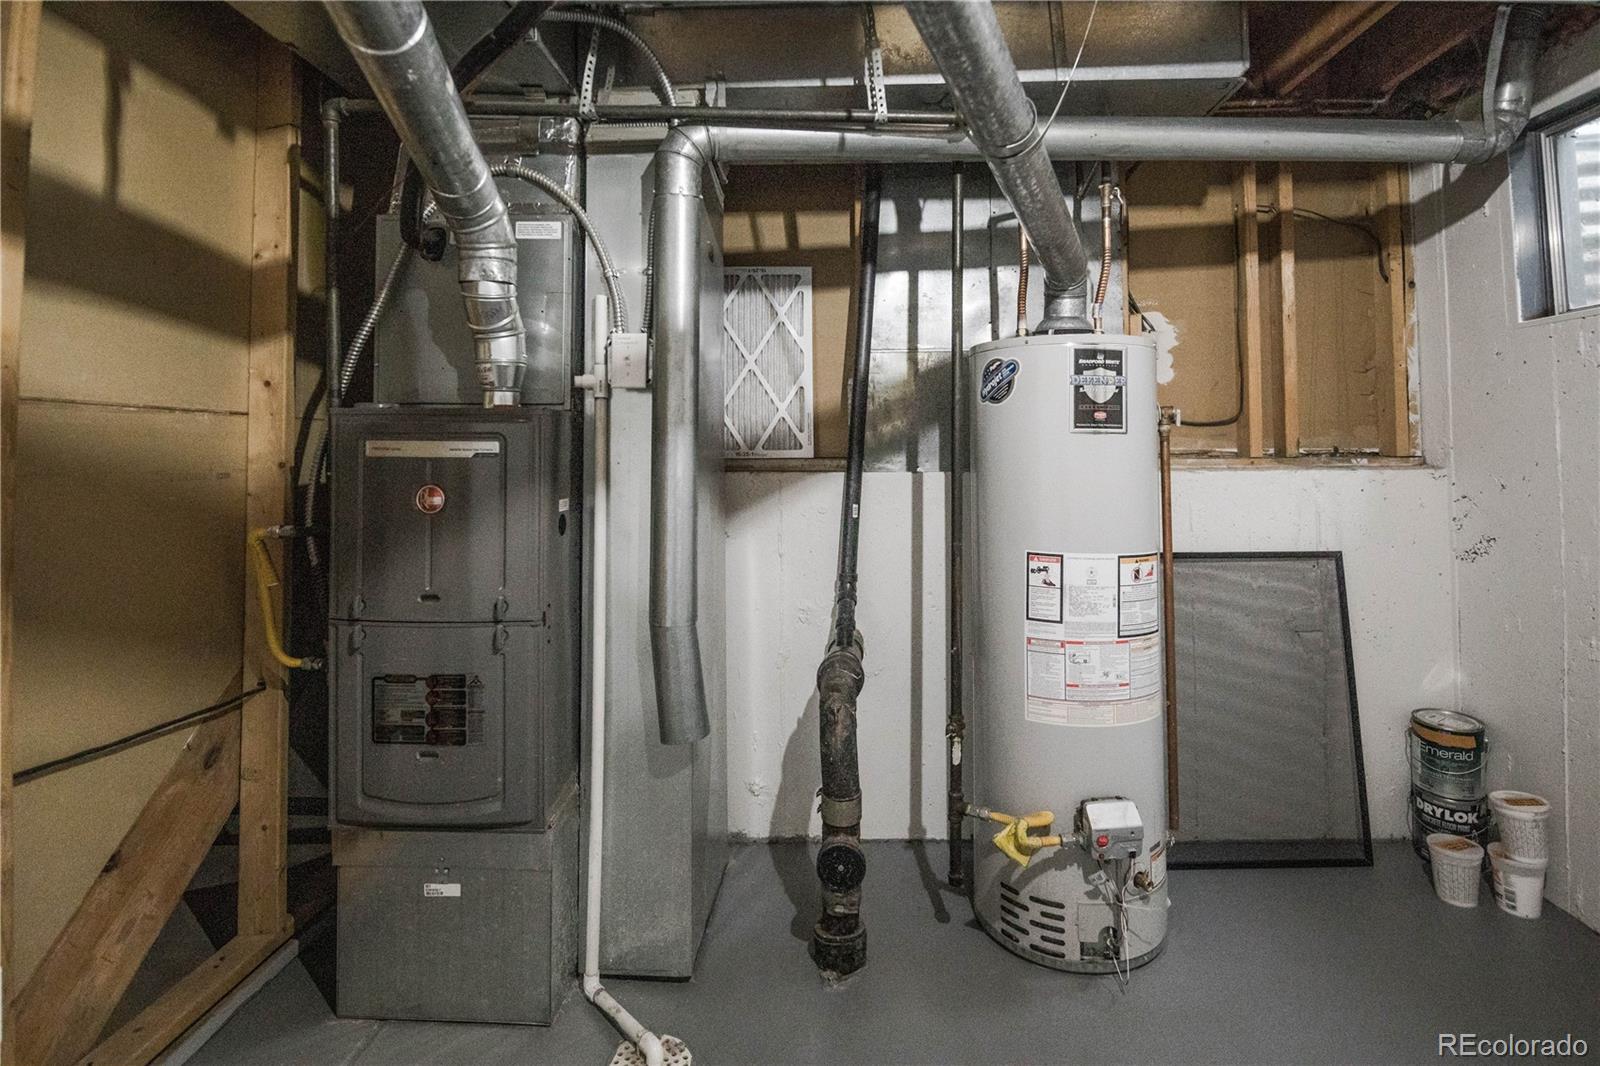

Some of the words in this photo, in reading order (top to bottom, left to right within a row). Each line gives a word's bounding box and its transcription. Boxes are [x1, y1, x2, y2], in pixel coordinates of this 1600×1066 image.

[1070, 375, 1126, 386] DEFENDER
[1420, 741, 1474, 761] Emerald
[1416, 796, 1479, 824] DRYLOK
